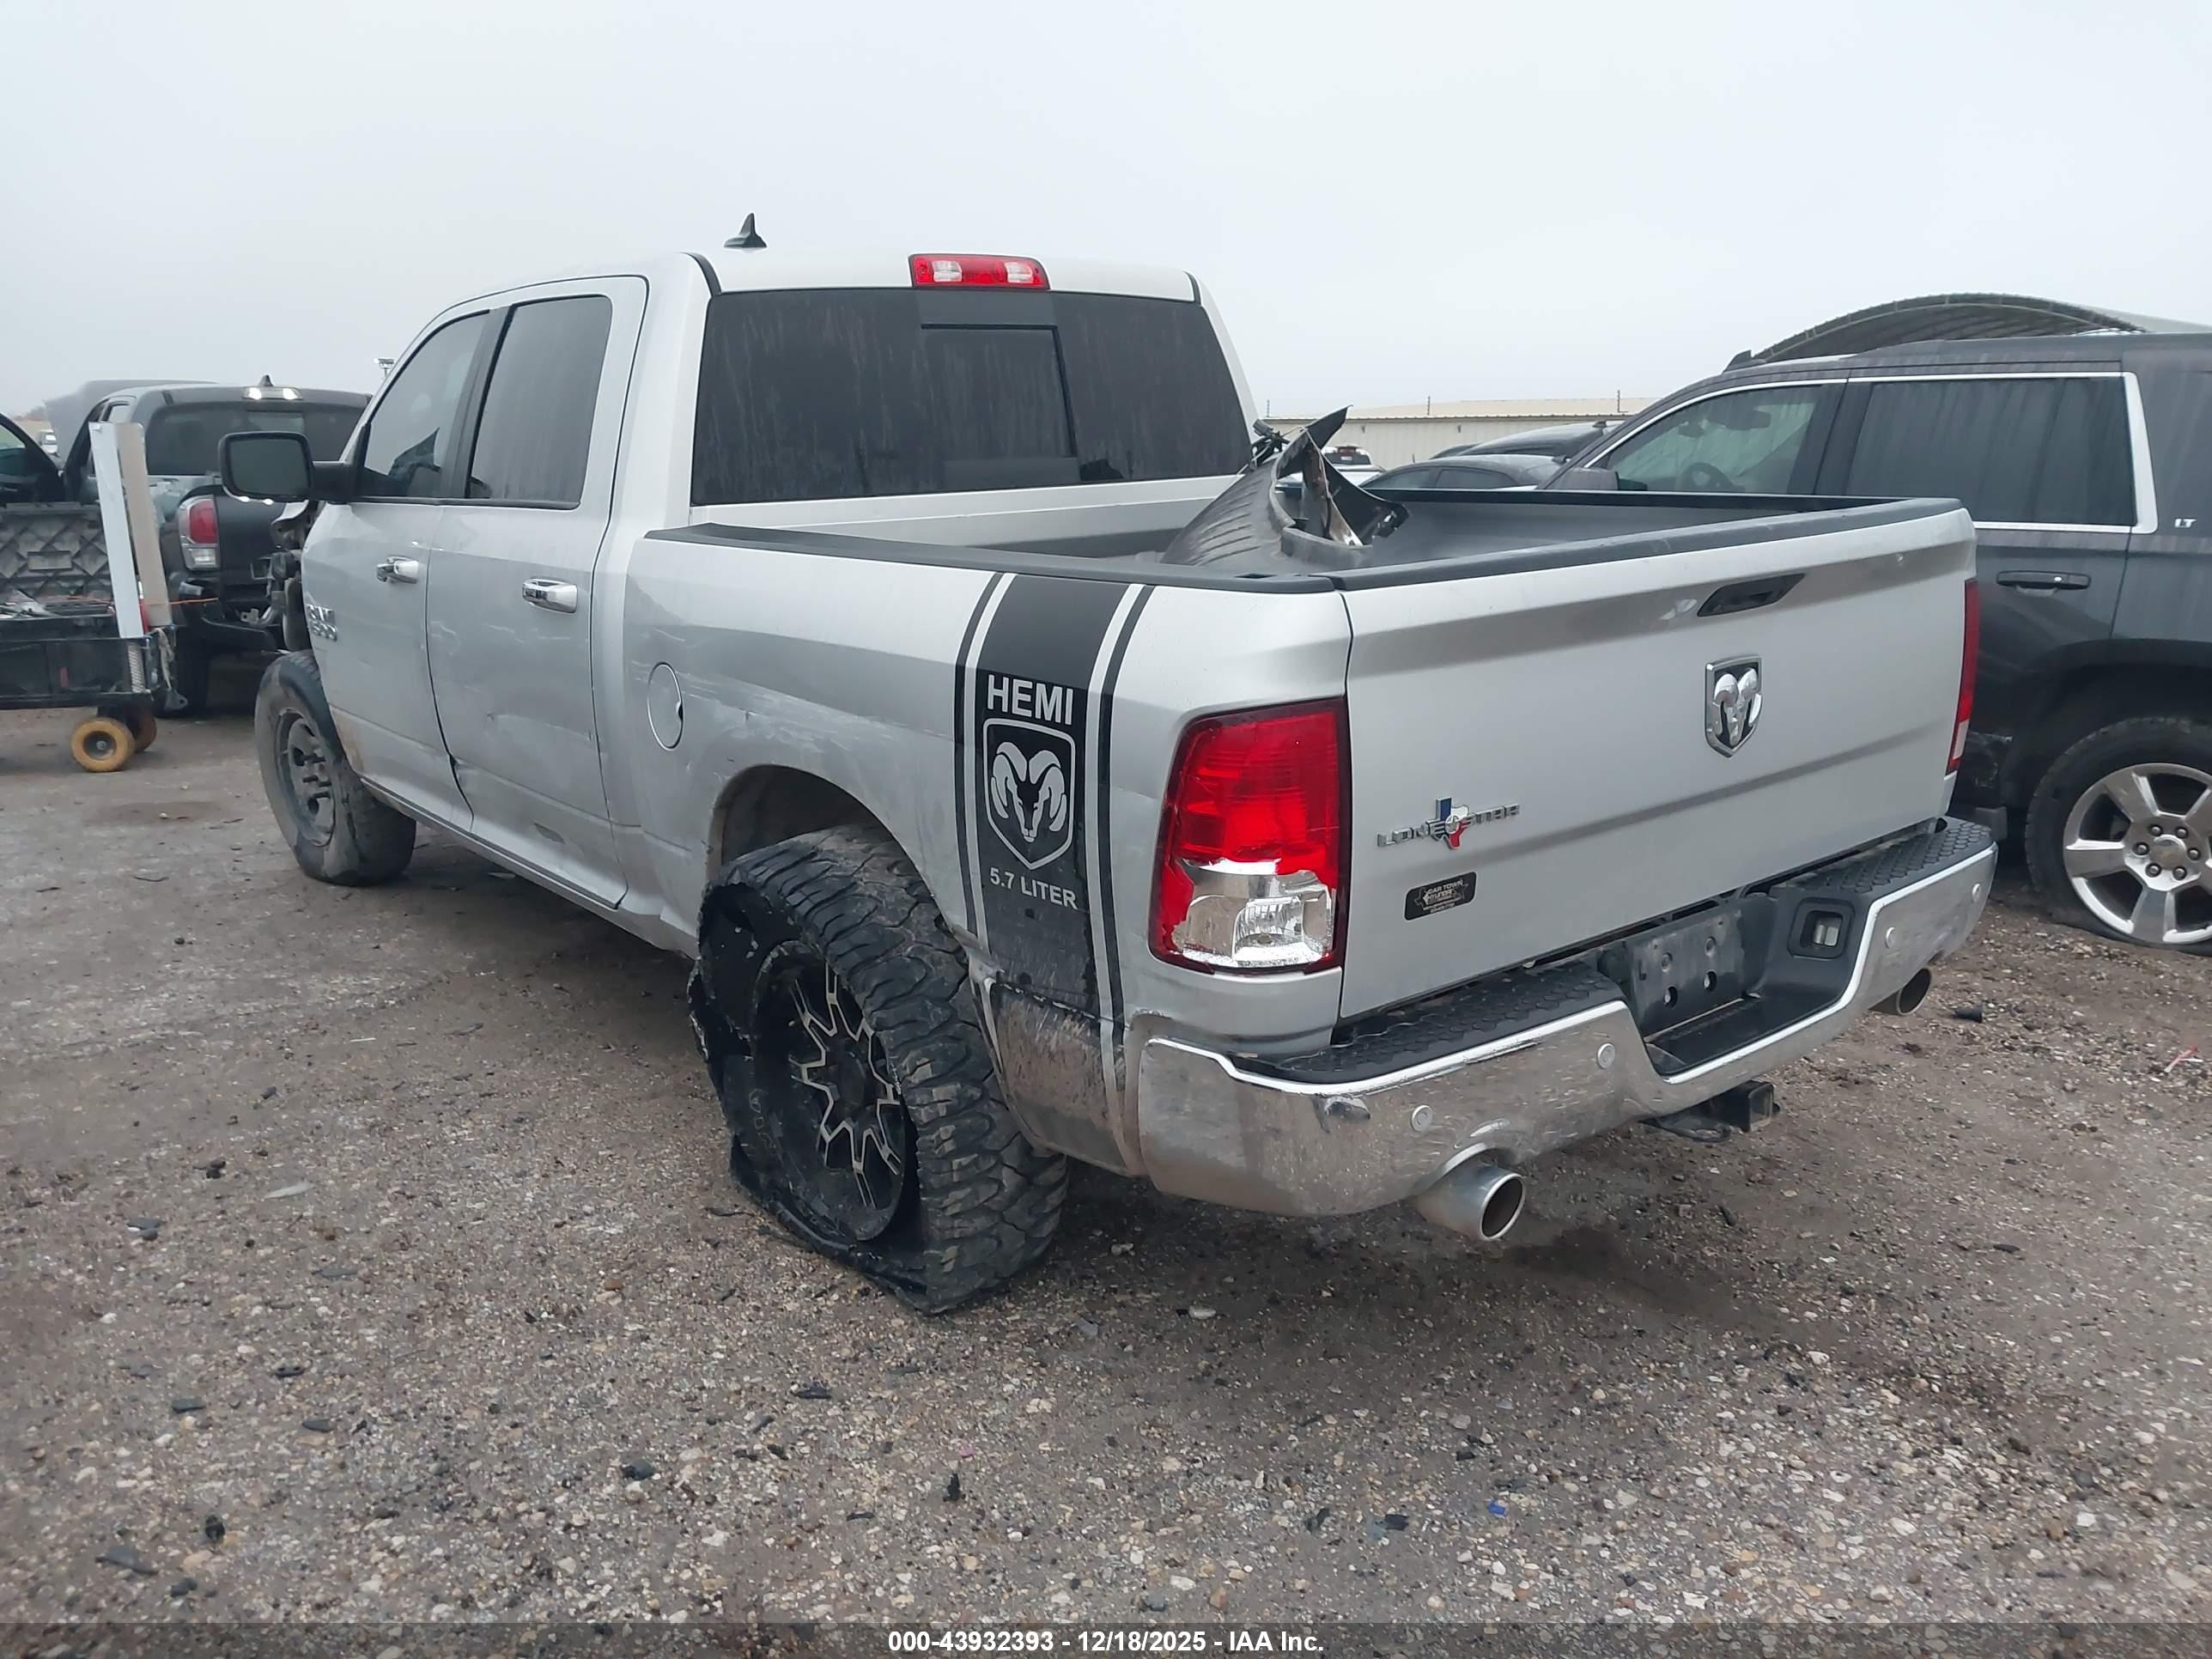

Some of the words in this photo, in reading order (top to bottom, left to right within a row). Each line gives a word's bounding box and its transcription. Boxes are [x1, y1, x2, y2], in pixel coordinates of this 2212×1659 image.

[2174, 518, 2197, 528] LT
[988, 674, 1073, 726] HEMI
[990, 866, 1015, 890] 5.7
[1020, 876, 1078, 910] LITER
